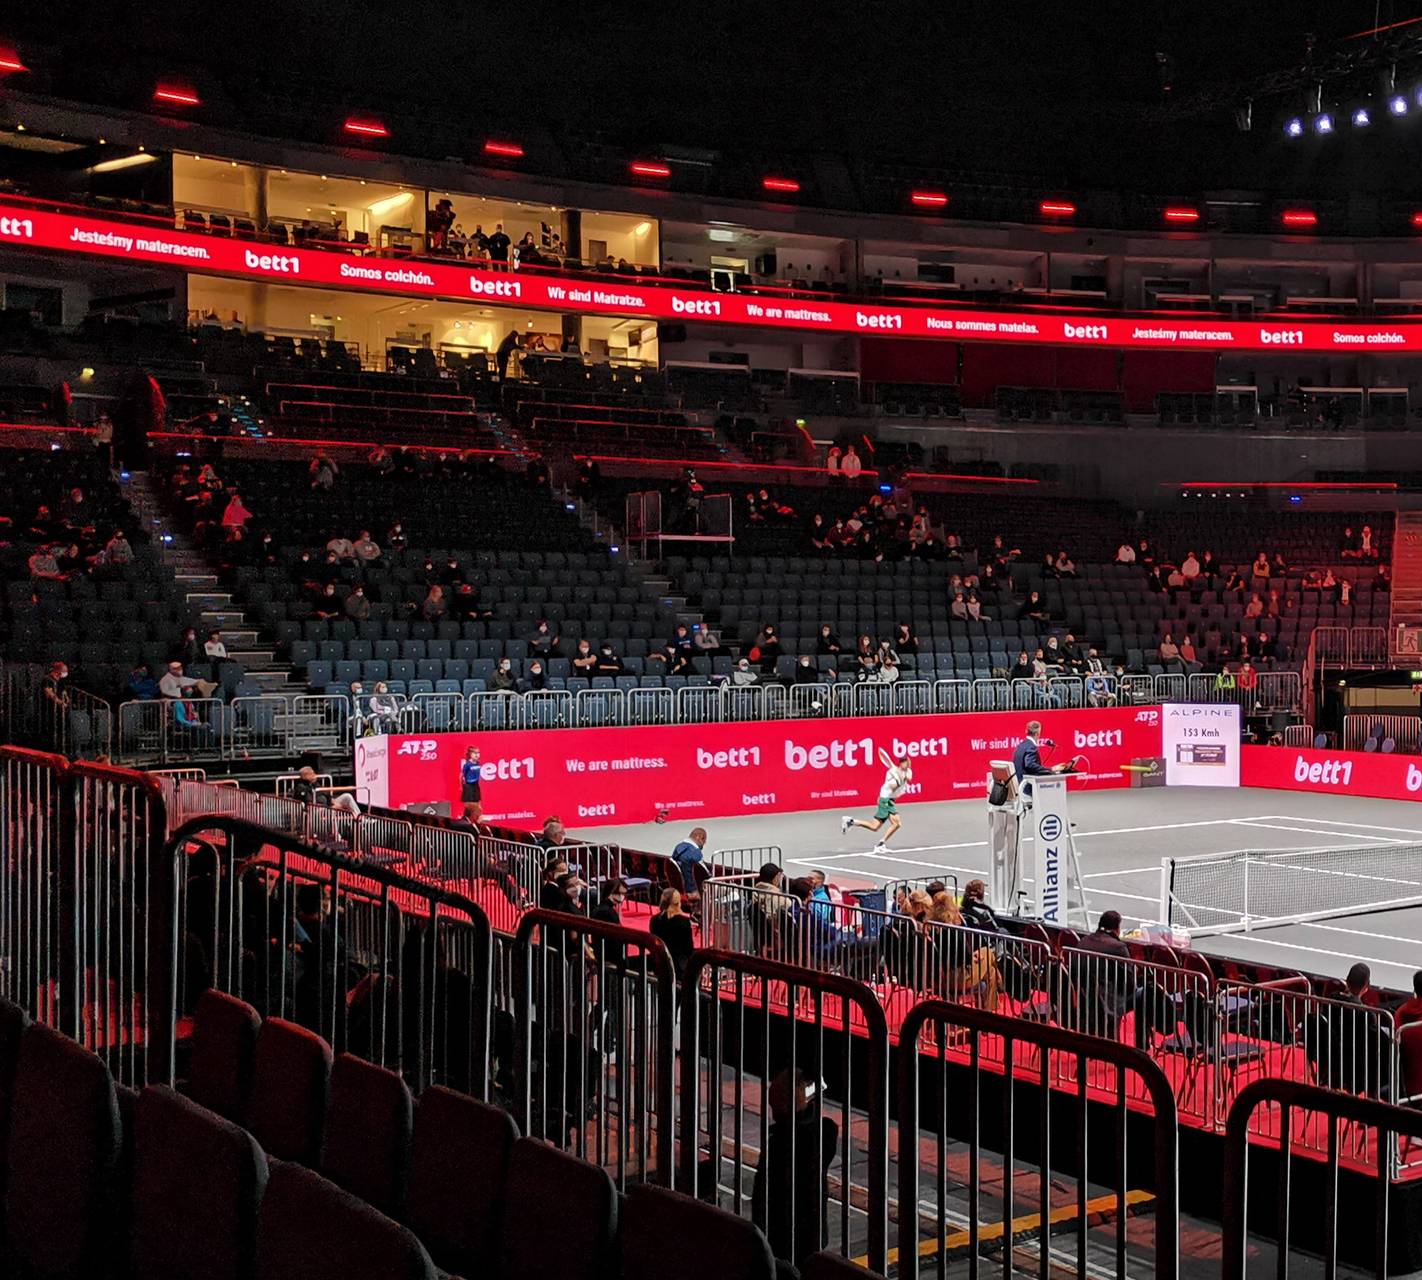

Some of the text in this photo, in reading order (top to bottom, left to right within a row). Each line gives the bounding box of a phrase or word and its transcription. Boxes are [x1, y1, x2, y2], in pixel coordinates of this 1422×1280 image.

[135, 238, 211, 260] materacem.
[244, 249, 300, 274] bett1
[340, 262, 435, 286] Somos colchón.
[469, 275, 522, 298] bett1
[547, 286, 646, 308] Wir sind Matratze.
[671, 295, 722, 316] bett1
[746, 303, 832, 322] We are mattress.
[856, 311, 902, 329] bett1
[926, 317, 1040, 334] Nous sommes matelas.
[1063, 322, 1108, 340] bett1
[1178, 329, 1235, 341] materacem.
[1260, 328, 1304, 345] bett1
[1332, 331, 1406, 344] Somos colchón.
[1134, 711, 1158, 722] ATP
[1170, 709, 1233, 717] ALPINE
[1074, 729, 1122, 748] bett1
[1183, 728, 1220, 737] 153 Kmh
[397, 740, 437, 755] ATP
[892, 737, 948, 758] bett1
[970, 739, 987, 751] Wir
[989, 737, 1009, 749] sind
[420, 752, 438, 761] 250
[697, 747, 760, 769] bett1
[784, 738, 874, 771] bett1
[461, 757, 535, 781] ett1
[566, 757, 668, 773] We are mattress.
[1294, 756, 1353, 785] bett1
[742, 793, 776, 805] bett1
[578, 804, 615, 817] bett1
[1043, 847, 1058, 922] Allianz
